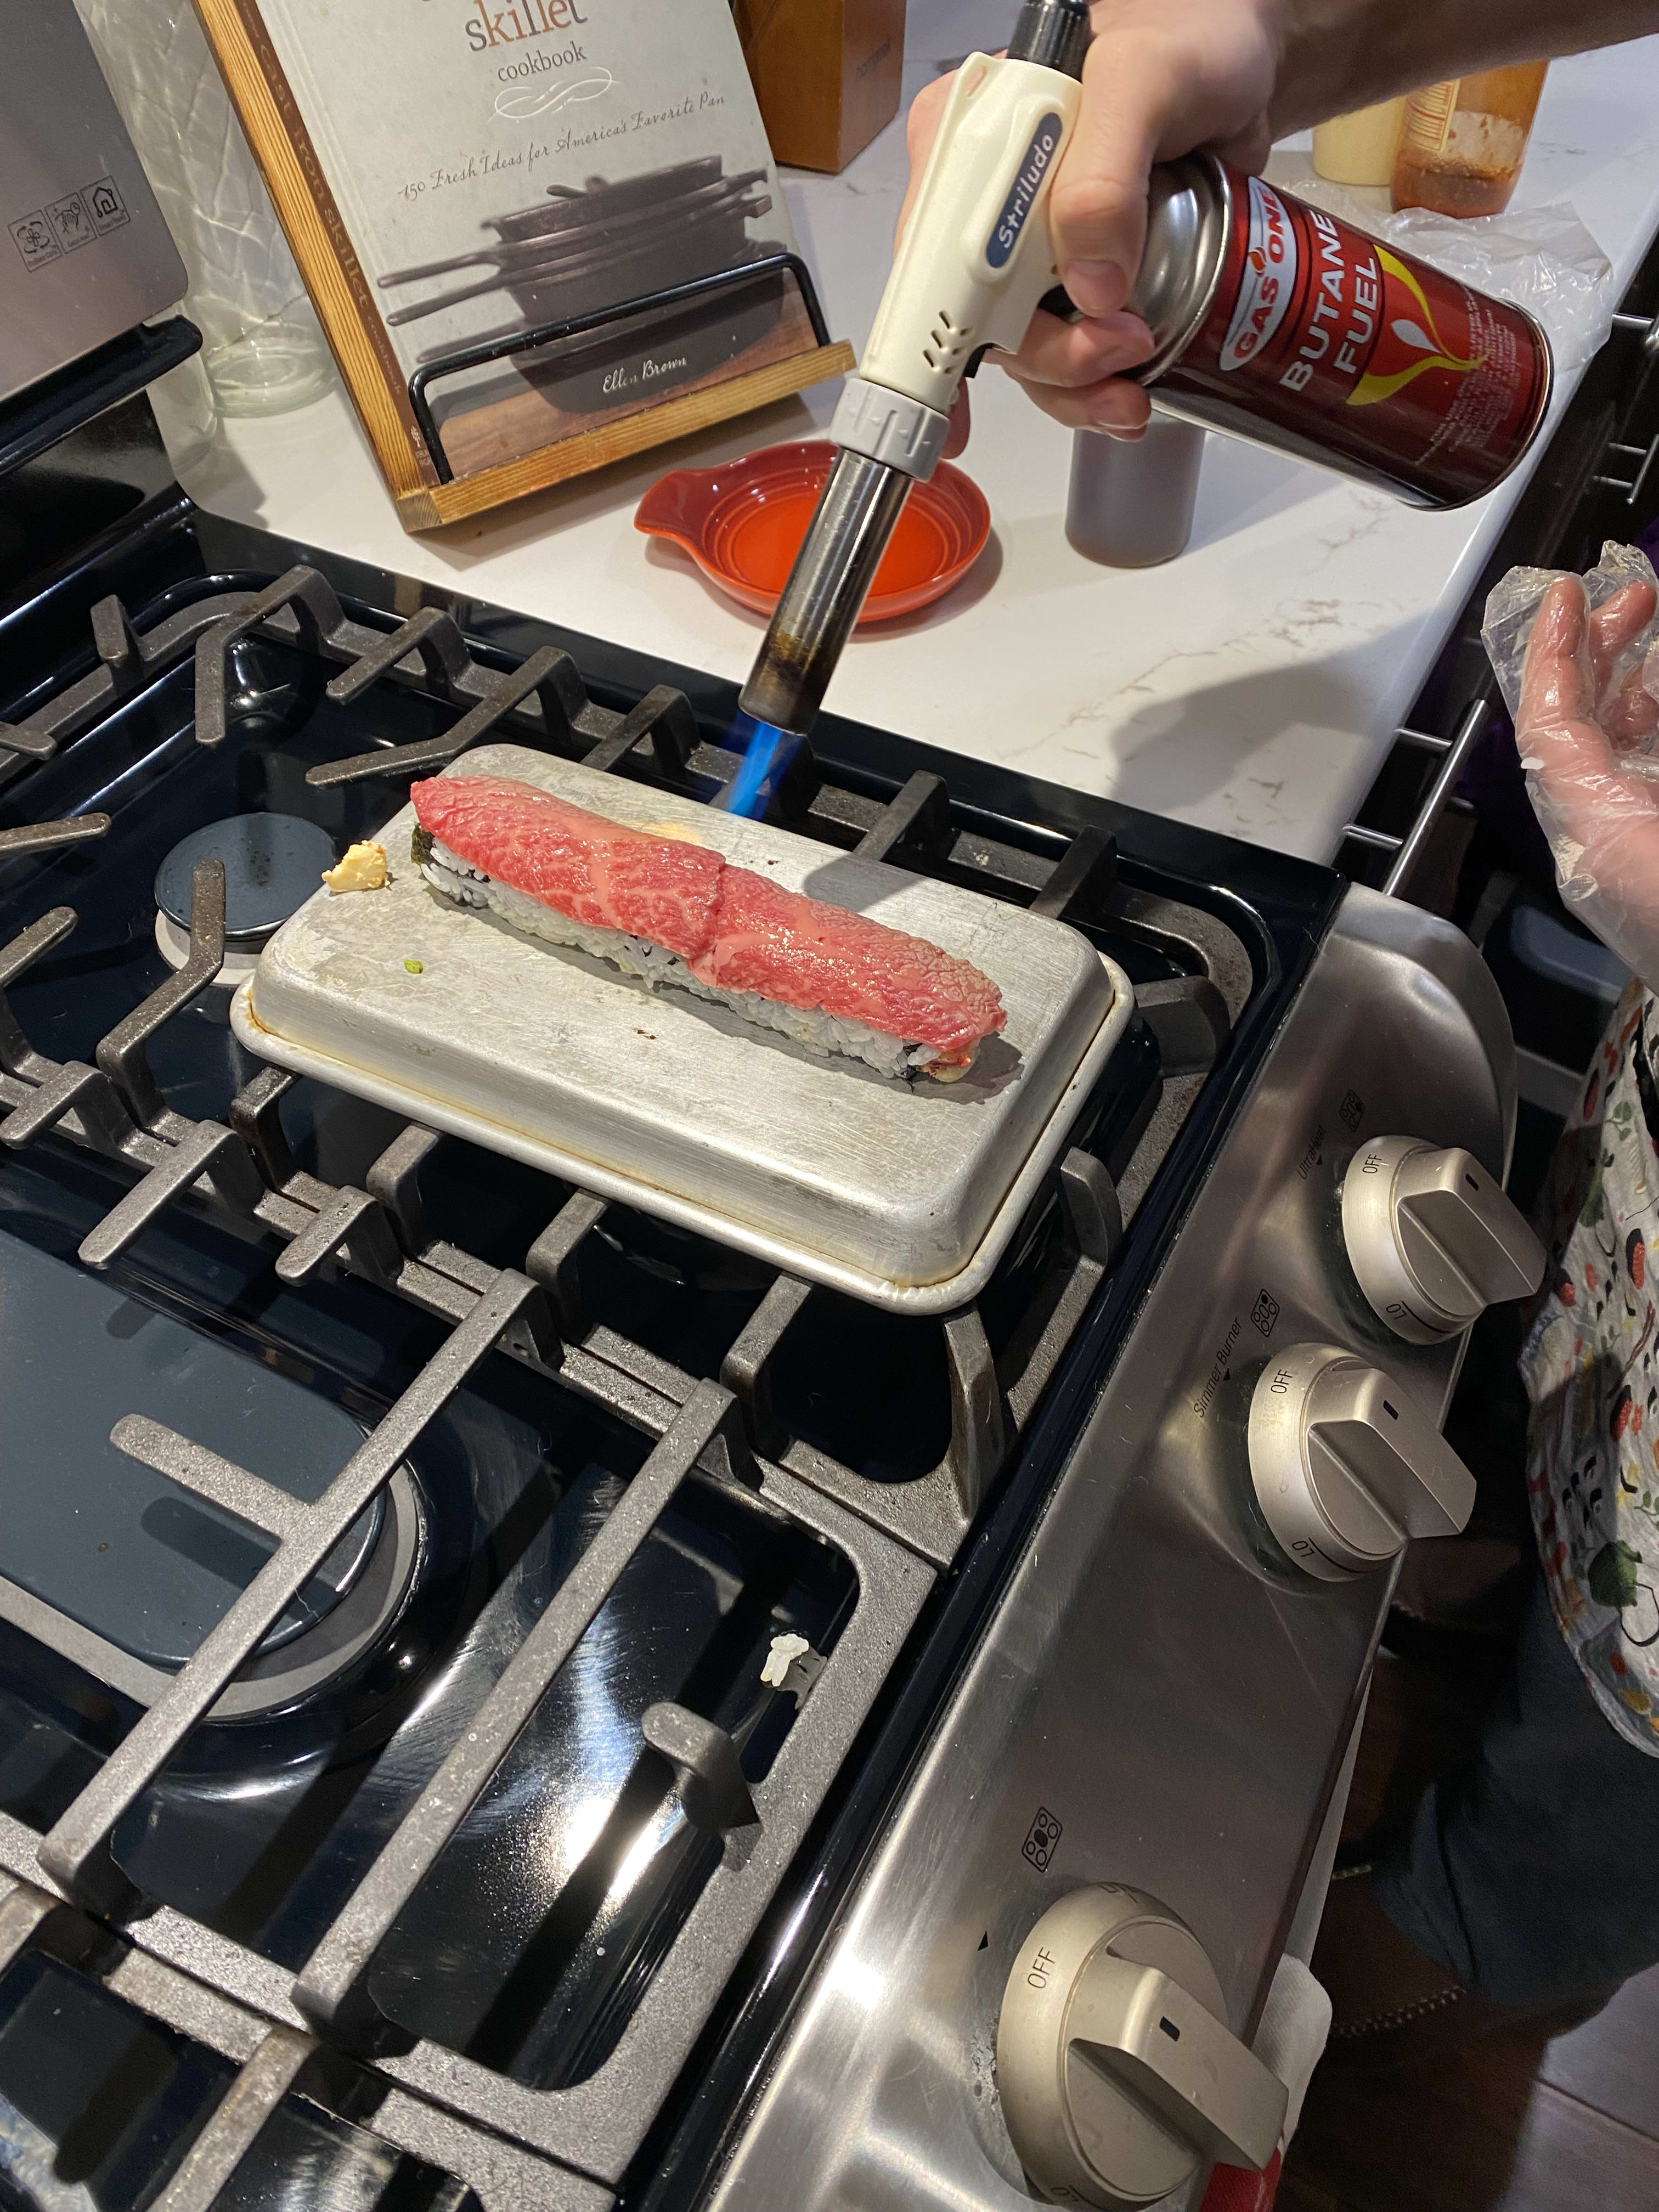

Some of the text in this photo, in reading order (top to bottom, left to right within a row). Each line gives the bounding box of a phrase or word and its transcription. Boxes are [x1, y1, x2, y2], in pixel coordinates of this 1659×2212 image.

[465, 0, 588, 51] skillet
[498, 40, 587, 82] cookbook
[398, 91, 724, 201] 150 Fresh Ideas for America's Favorite Pan
[997, 133, 1054, 250] Striludo
[324, 208, 369, 308] skillet
[1234, 185, 1285, 359] GAS ONE
[1280, 210, 1345, 393] BUTANE
[1334, 257, 1378, 375] FUEL
[603, 357, 686, 393] Ellen Brown
[1297, 1126, 1327, 1180] UltraHeat
[1362, 1154, 1382, 1173] OFF
[1386, 1304, 1407, 1319] LO
[1194, 1317, 1242, 1418] Simmer Burner
[1271, 1369, 1293, 1393] OFF
[1292, 1541, 1315, 1557] LO
[1027, 1947, 1056, 1989] OFF
